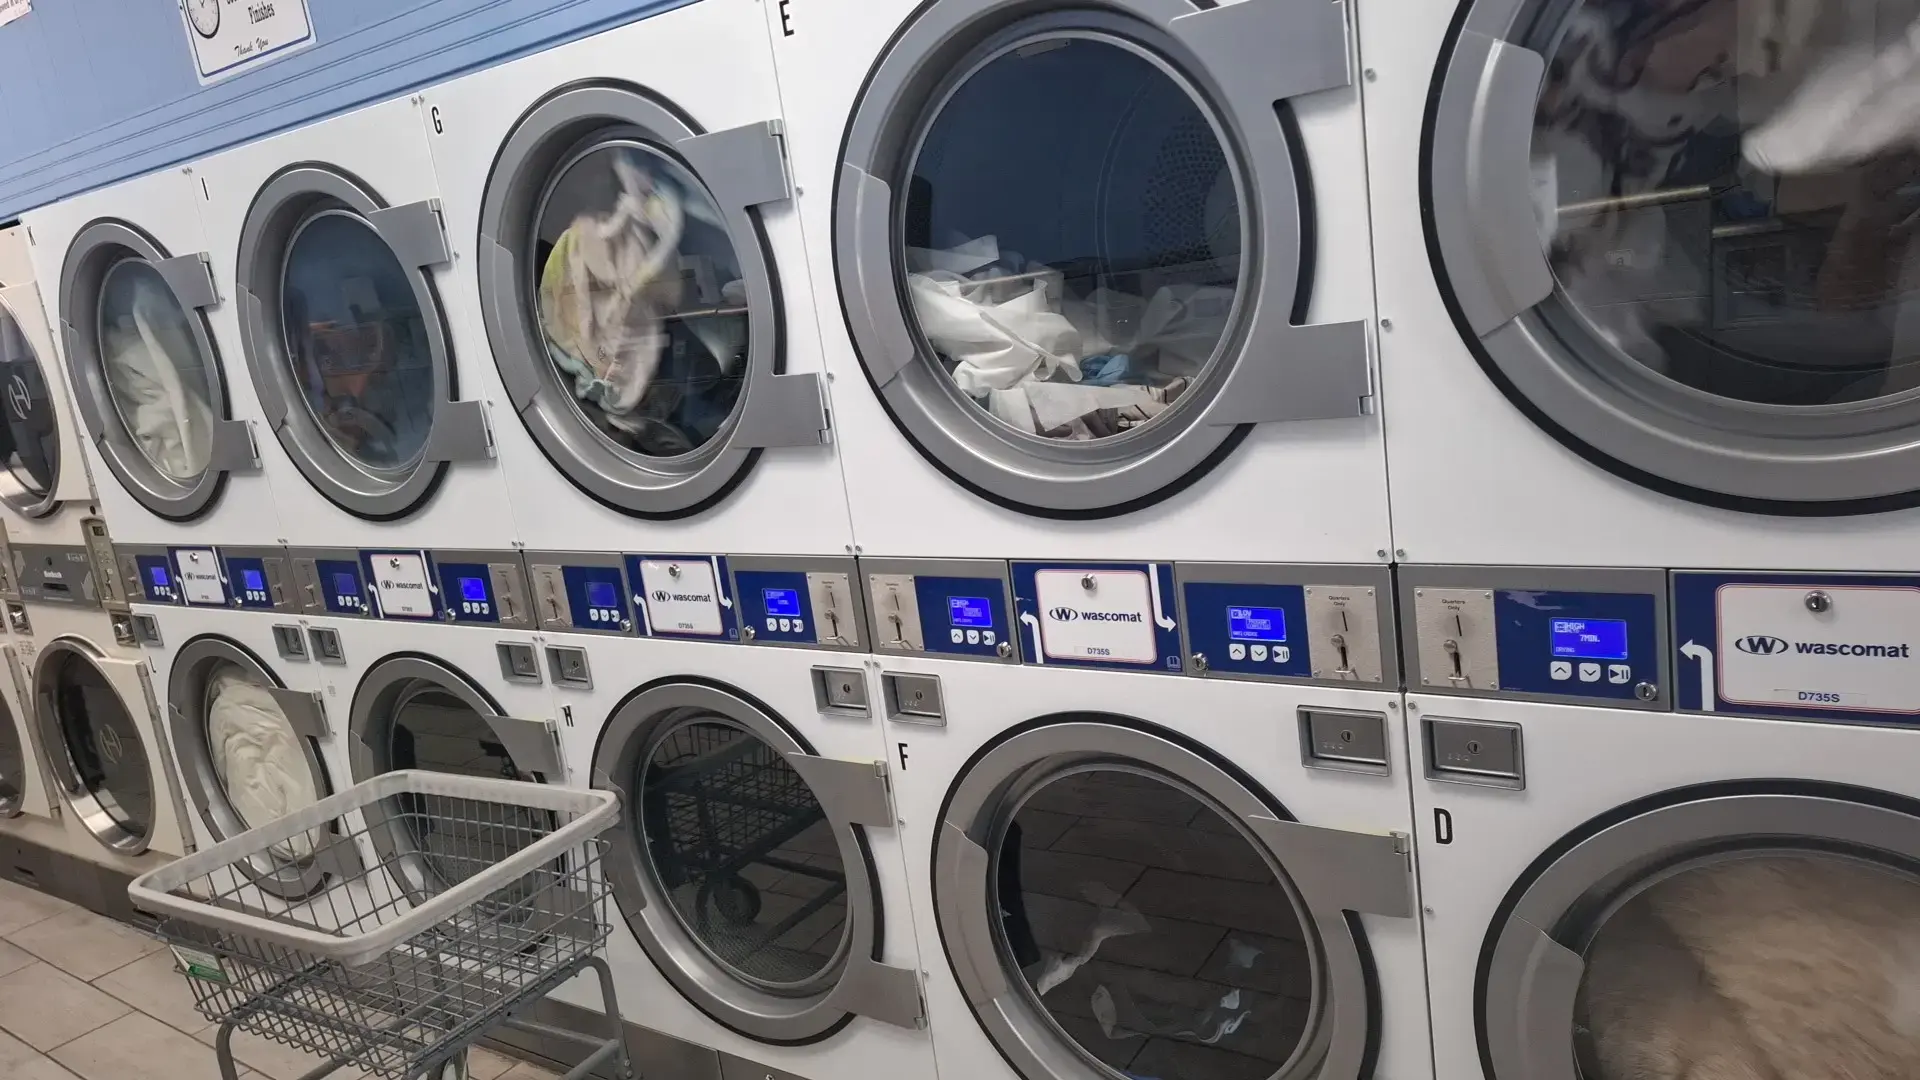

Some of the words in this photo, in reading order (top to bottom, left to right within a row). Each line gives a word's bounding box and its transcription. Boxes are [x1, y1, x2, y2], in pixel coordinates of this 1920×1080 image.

[247, 3, 275, 24] Finishes
[779, 0, 794, 37] E
[234, 41, 254, 57] Thank
[255, 37, 269, 51] You
[431, 106, 443, 134] G
[395, 582, 424, 590] wascomat
[672, 594, 712, 603] wascomat
[1081, 612, 1142, 623] wascomat
[1566, 622, 1585, 631] HIGH
[1087, 647, 1110, 656] D735S
[1795, 642, 1910, 658] wascomat
[1798, 691, 1841, 703] D735S
[561, 705, 574, 728] H
[898, 742, 908, 770] F
[1434, 807, 1453, 845] D
